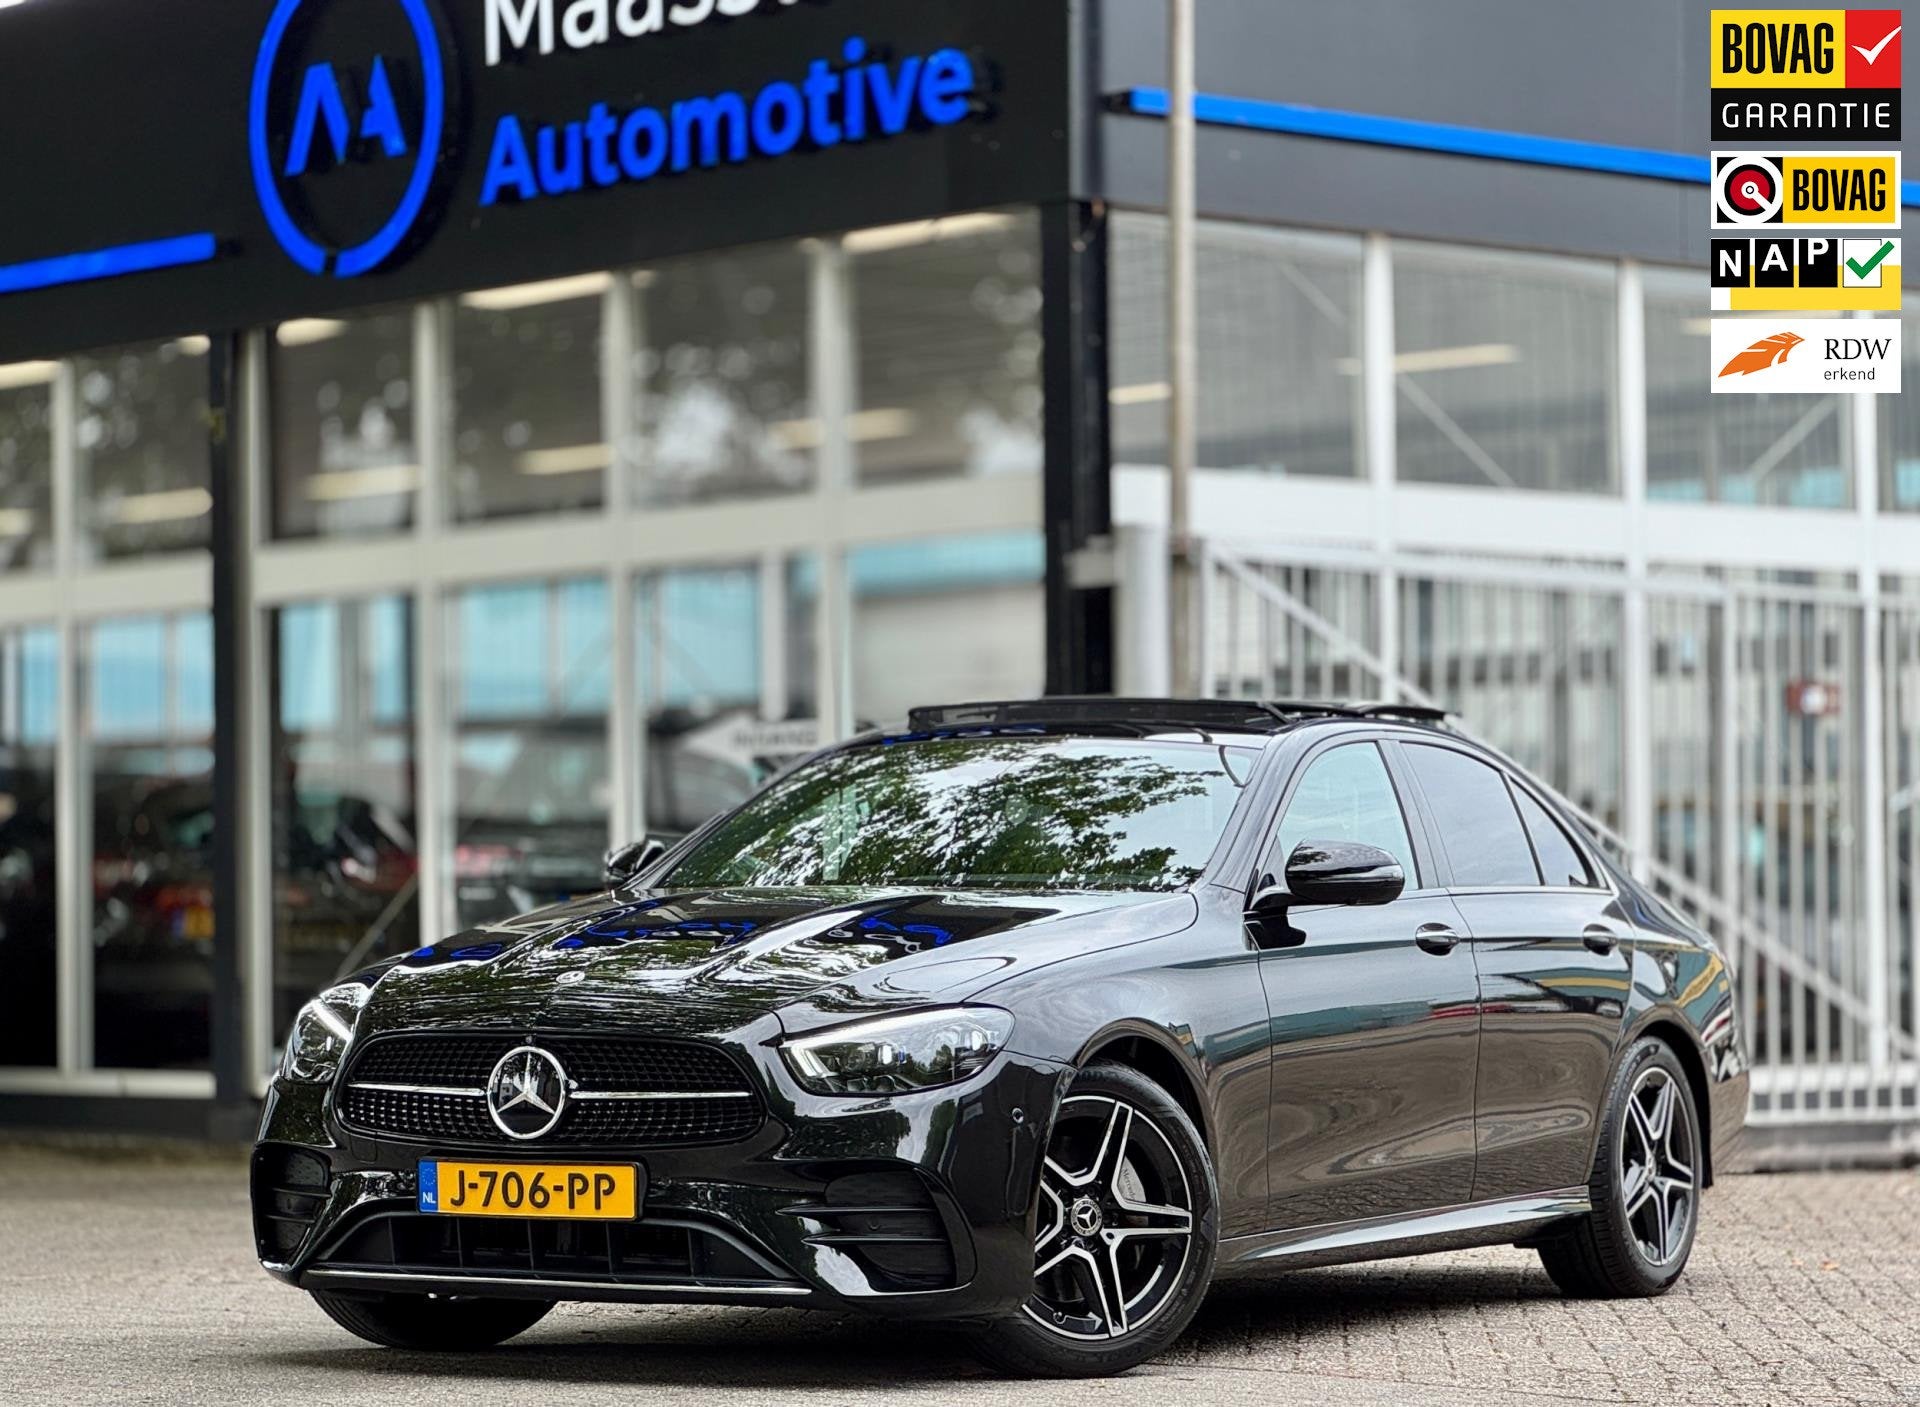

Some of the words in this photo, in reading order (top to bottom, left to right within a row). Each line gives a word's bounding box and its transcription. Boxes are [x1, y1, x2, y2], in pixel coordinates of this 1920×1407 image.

[480, 37, 974, 205] Automotive
[422, 1191, 436, 1204] NL
[450, 1169, 616, 1211] J-706-PP
